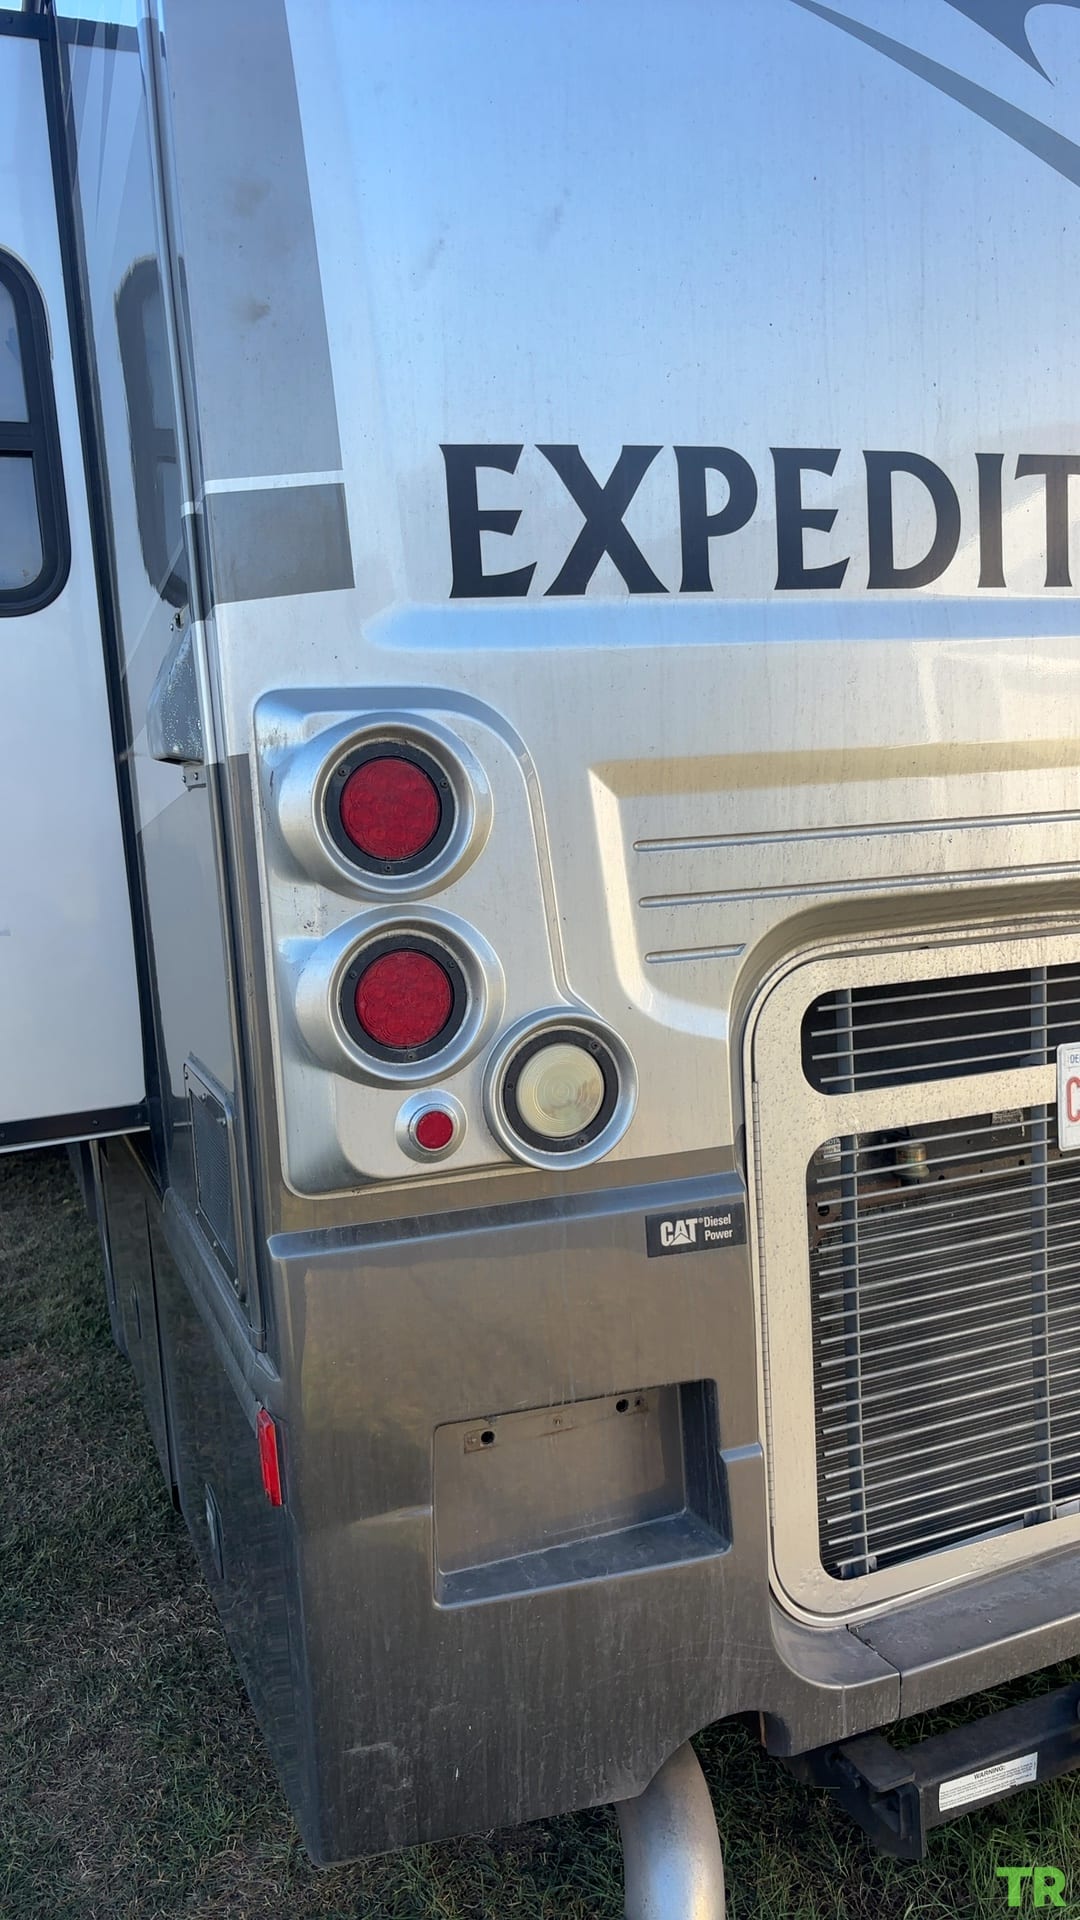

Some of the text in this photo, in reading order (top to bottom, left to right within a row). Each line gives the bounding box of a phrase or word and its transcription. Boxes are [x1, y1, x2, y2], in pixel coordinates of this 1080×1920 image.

[439, 443, 1080, 598] EXPEDIT
[704, 1213, 731, 1228] Diesel
[660, 1218, 698, 1247] CAT
[704, 1229, 733, 1241] Power
